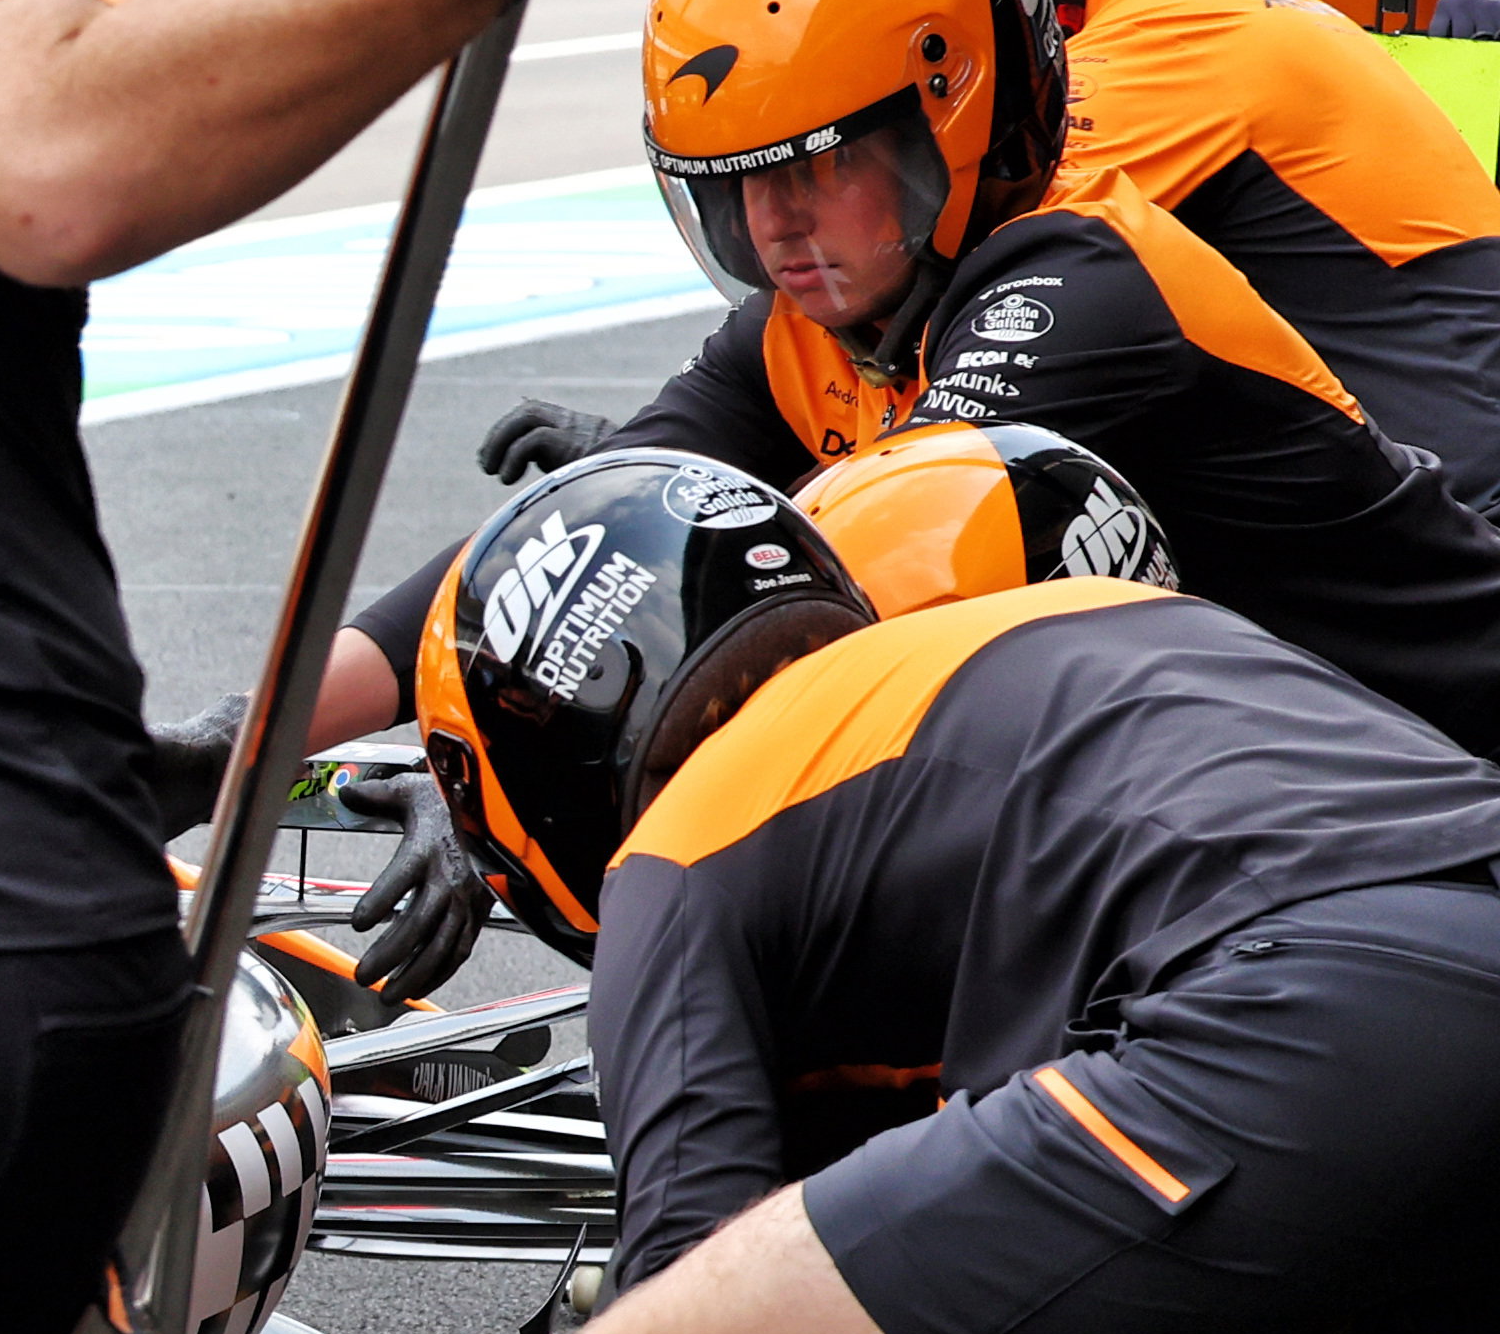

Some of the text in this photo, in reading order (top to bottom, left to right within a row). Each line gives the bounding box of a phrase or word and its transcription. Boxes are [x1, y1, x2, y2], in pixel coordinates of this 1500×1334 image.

[660, 154, 710, 175] OPTIMUM
[712, 142, 795, 175] NUTRITION
[805, 126, 837, 153] ON
[984, 307, 1039, 320] Estrella
[984, 318, 1034, 331] Galicia
[676, 471, 752, 503] Estrella
[694, 489, 763, 517] Galicia
[1062, 476, 1136, 579] ON
[752, 549, 787, 562] BELL
[483, 510, 576, 665] ON
[753, 573, 813, 592] Joe James
[536, 551, 638, 691] OPTIMUM
[552, 565, 658, 701] NUTRITION
